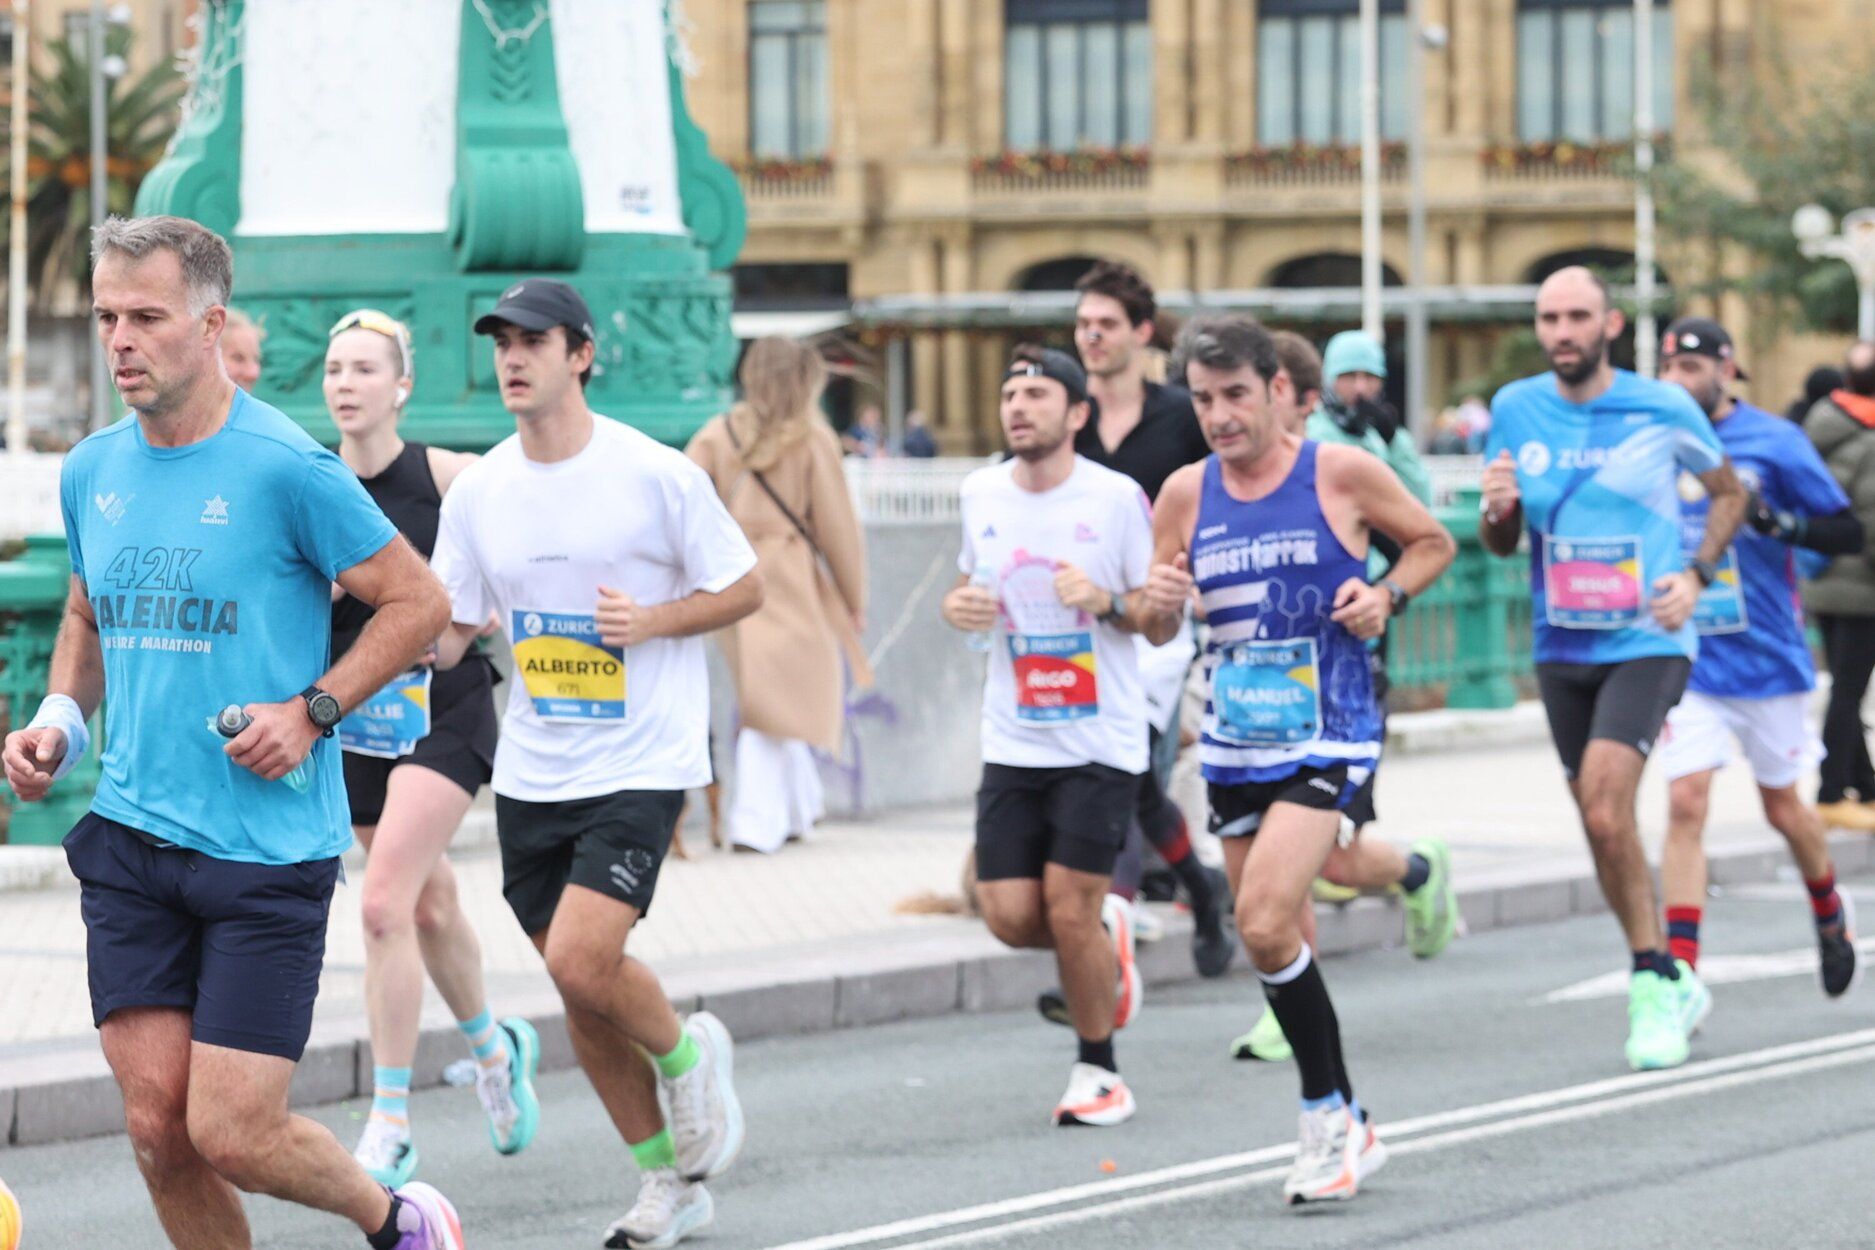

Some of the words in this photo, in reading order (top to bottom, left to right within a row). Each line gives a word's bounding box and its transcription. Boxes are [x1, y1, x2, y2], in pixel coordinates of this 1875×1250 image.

[104, 547, 202, 592] 42K
[140, 636, 212, 653] MARATHON
[525, 659, 618, 676] ALBERTO
